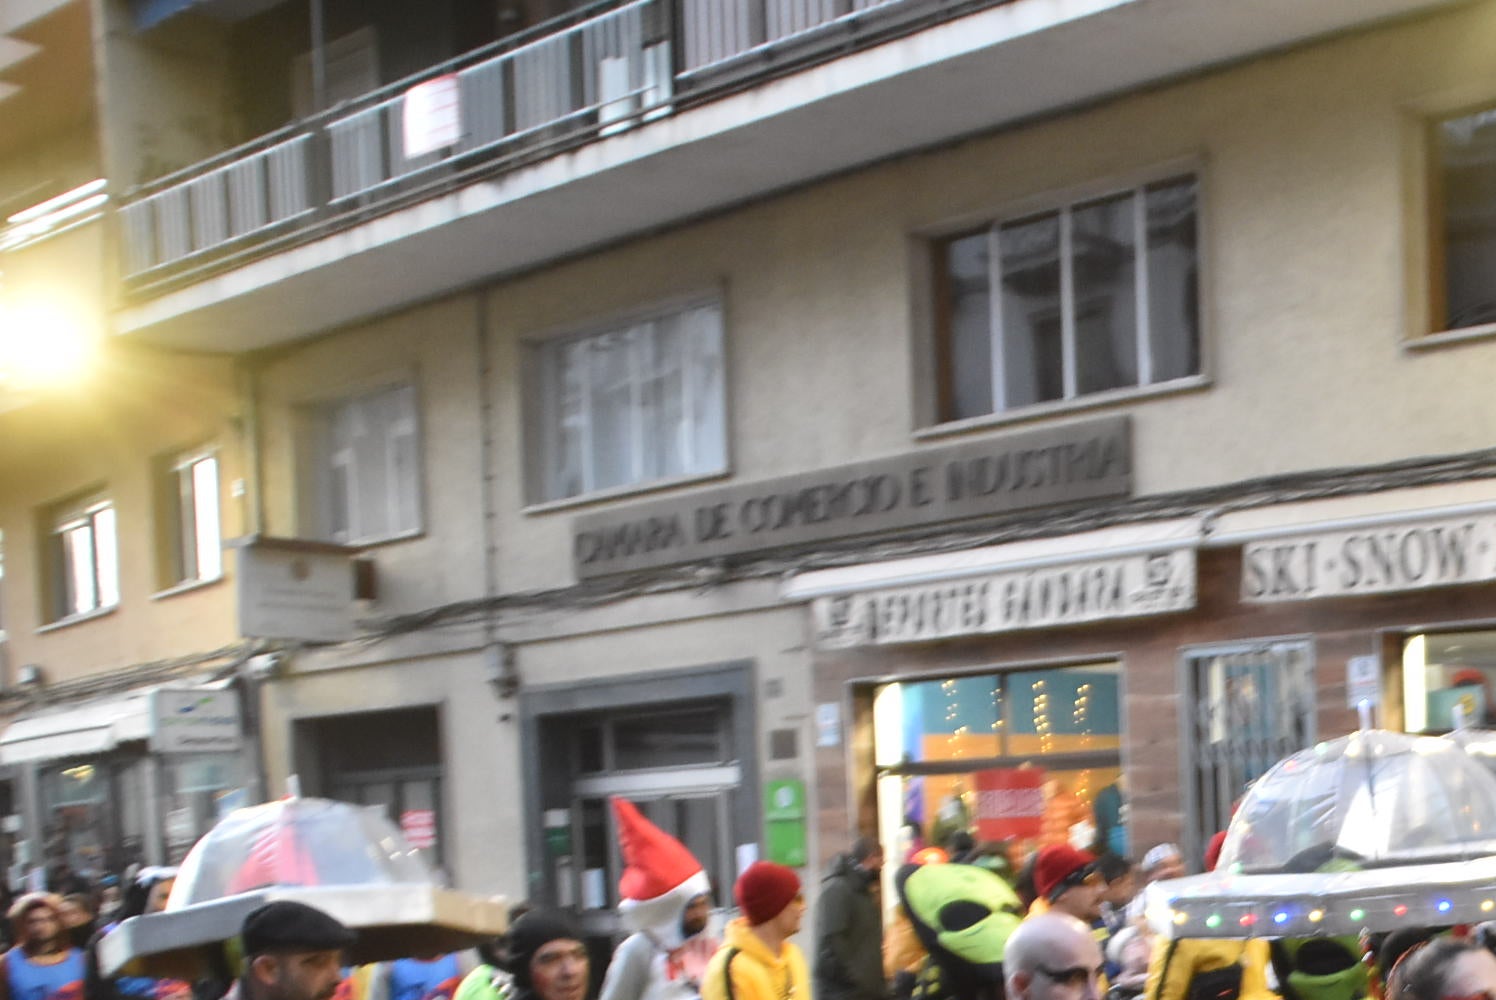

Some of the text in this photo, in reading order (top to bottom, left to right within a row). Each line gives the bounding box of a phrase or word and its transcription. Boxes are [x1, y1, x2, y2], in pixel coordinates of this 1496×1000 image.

[694, 502, 736, 542] DE
[739, 472, 902, 534] COMERCIO
[908, 465, 936, 508] E
[945, 437, 1132, 500] INDUSTRIA
[1247, 541, 1318, 598] SKI
[1342, 522, 1476, 588] SNOW
